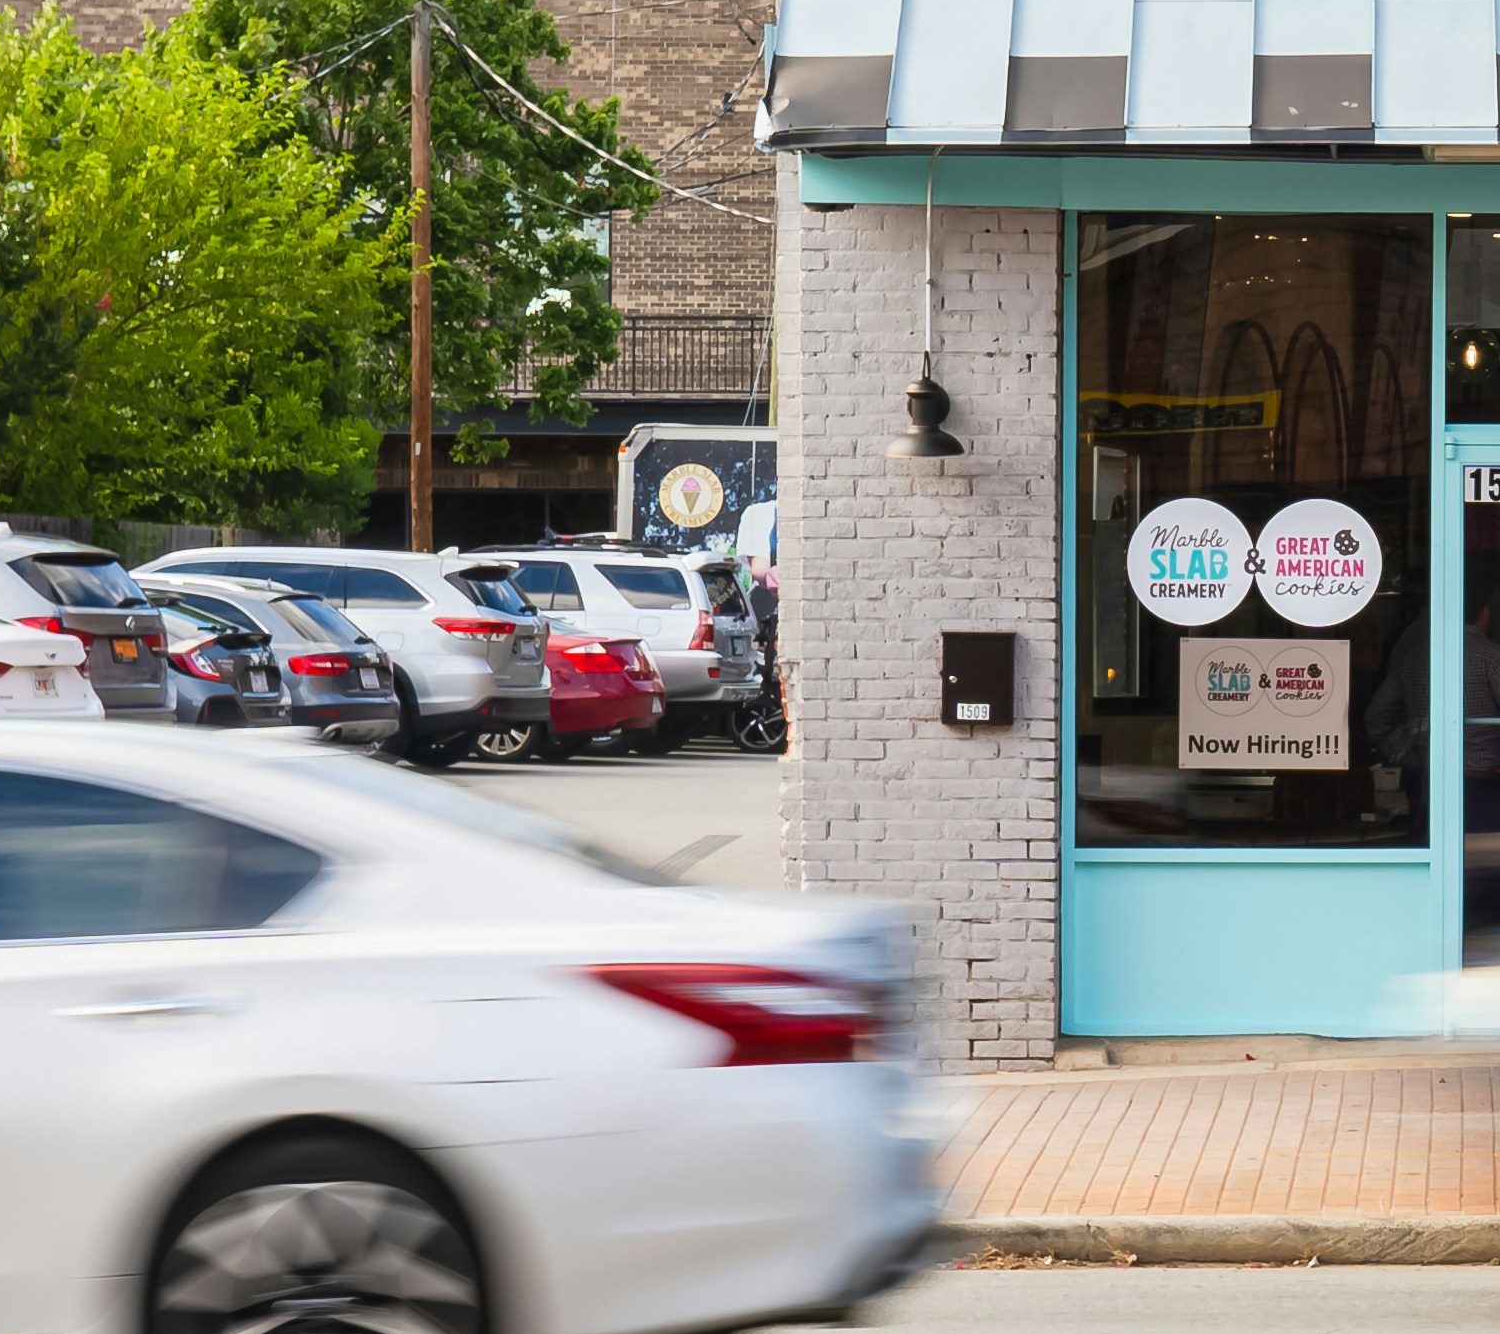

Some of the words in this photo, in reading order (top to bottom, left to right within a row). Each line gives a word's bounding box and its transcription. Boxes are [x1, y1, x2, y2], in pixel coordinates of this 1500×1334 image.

[1150, 525, 1229, 552] Marble
[1276, 536, 1330, 555] GREAT
[1150, 549, 1229, 580] SLAB
[1244, 548, 1266, 575] &
[1275, 559, 1364, 577] AMERICAN
[1150, 583, 1226, 598] CREAMERY
[1275, 574, 1365, 597] cookies
[1208, 661, 1251, 674] Marble
[1275, 667, 1305, 678] GREAT
[1208, 673, 1251, 691] SLAB
[1258, 673, 1271, 689] &
[1275, 679, 1325, 690] AMERICAN
[1207, 693, 1249, 702] CREAMERY
[1275, 689, 1324, 701] cookies
[960, 705, 988, 719] 1509
[1188, 734, 1240, 754] Now
[1247, 734, 1339, 759] Hiring!!!
